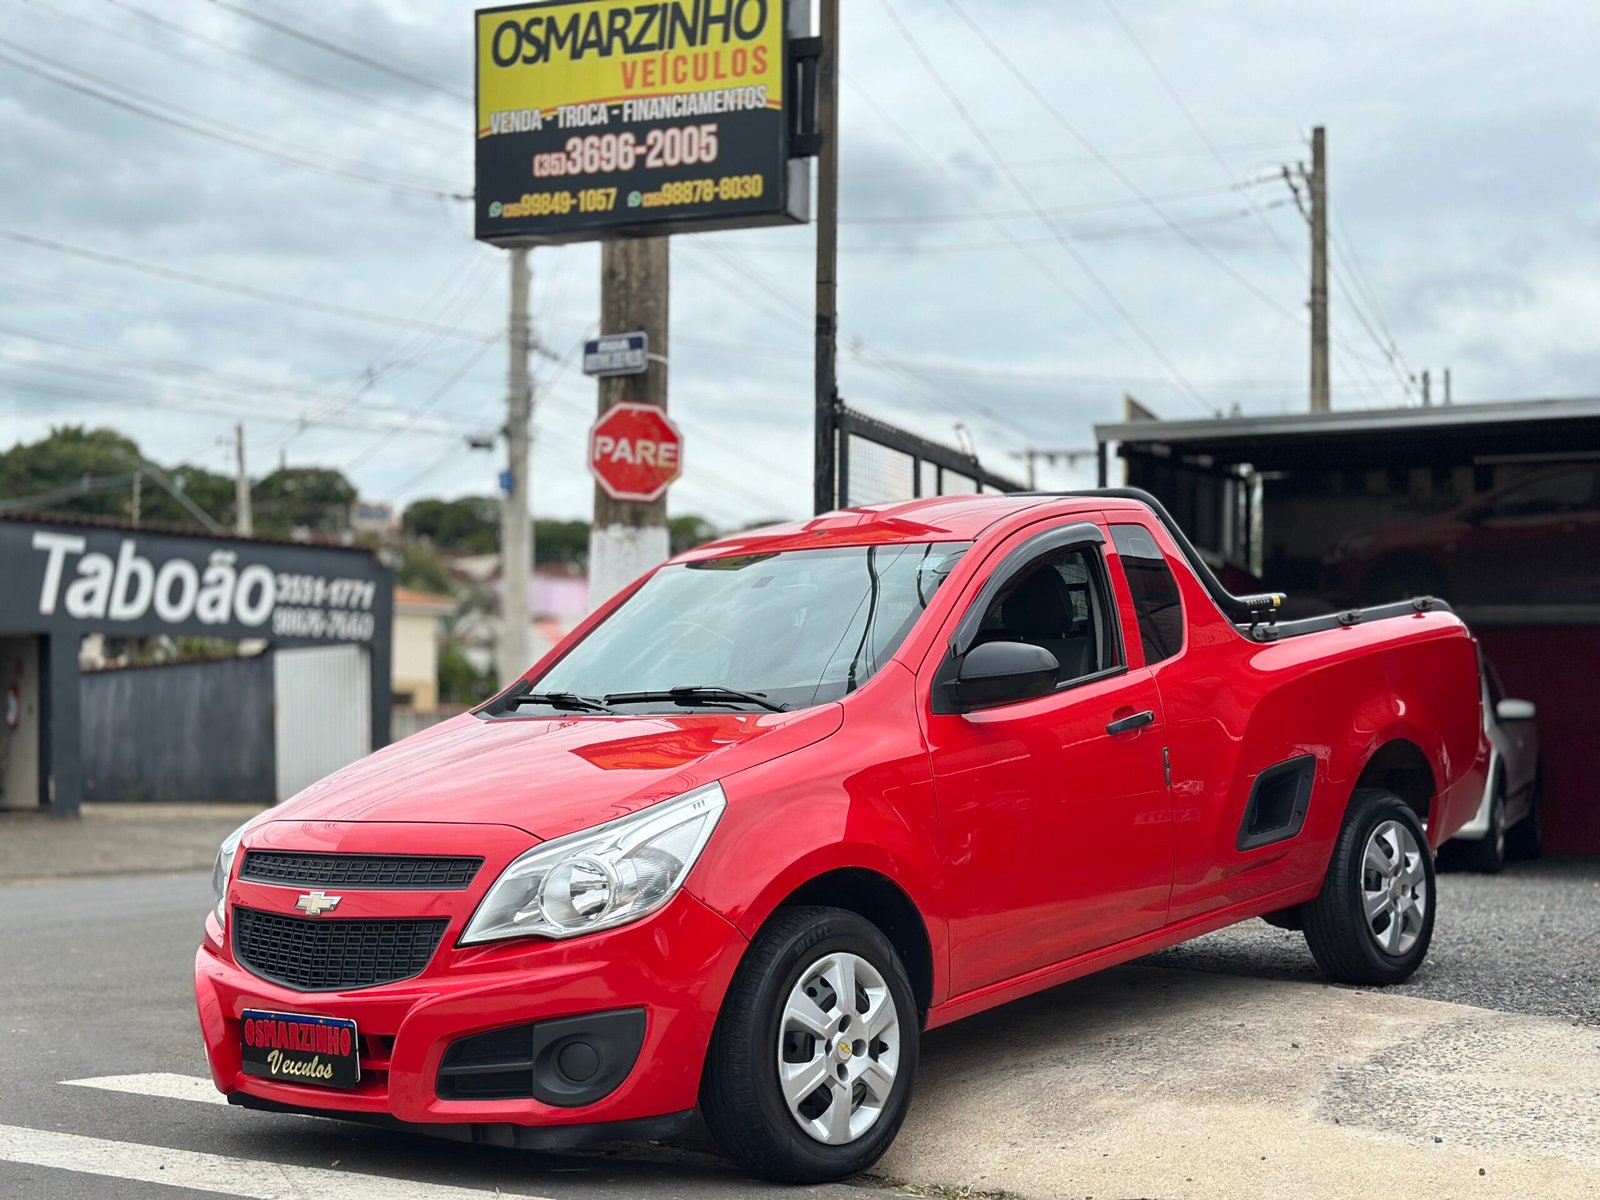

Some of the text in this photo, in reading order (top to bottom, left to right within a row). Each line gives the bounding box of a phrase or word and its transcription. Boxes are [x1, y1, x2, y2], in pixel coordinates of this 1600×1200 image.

[491, 0, 768, 68] OSMARZINHO
[620, 45, 768, 91] VEÍCULOS
[489, 108, 544, 135] VENDA
[556, 103, 610, 129] TROCA
[622, 84, 768, 123] FINANCIAMENTOS
[594, 434, 677, 469] PARE
[31, 530, 275, 628] Taboão
[244, 1018, 352, 1057] OSMARZINHO
